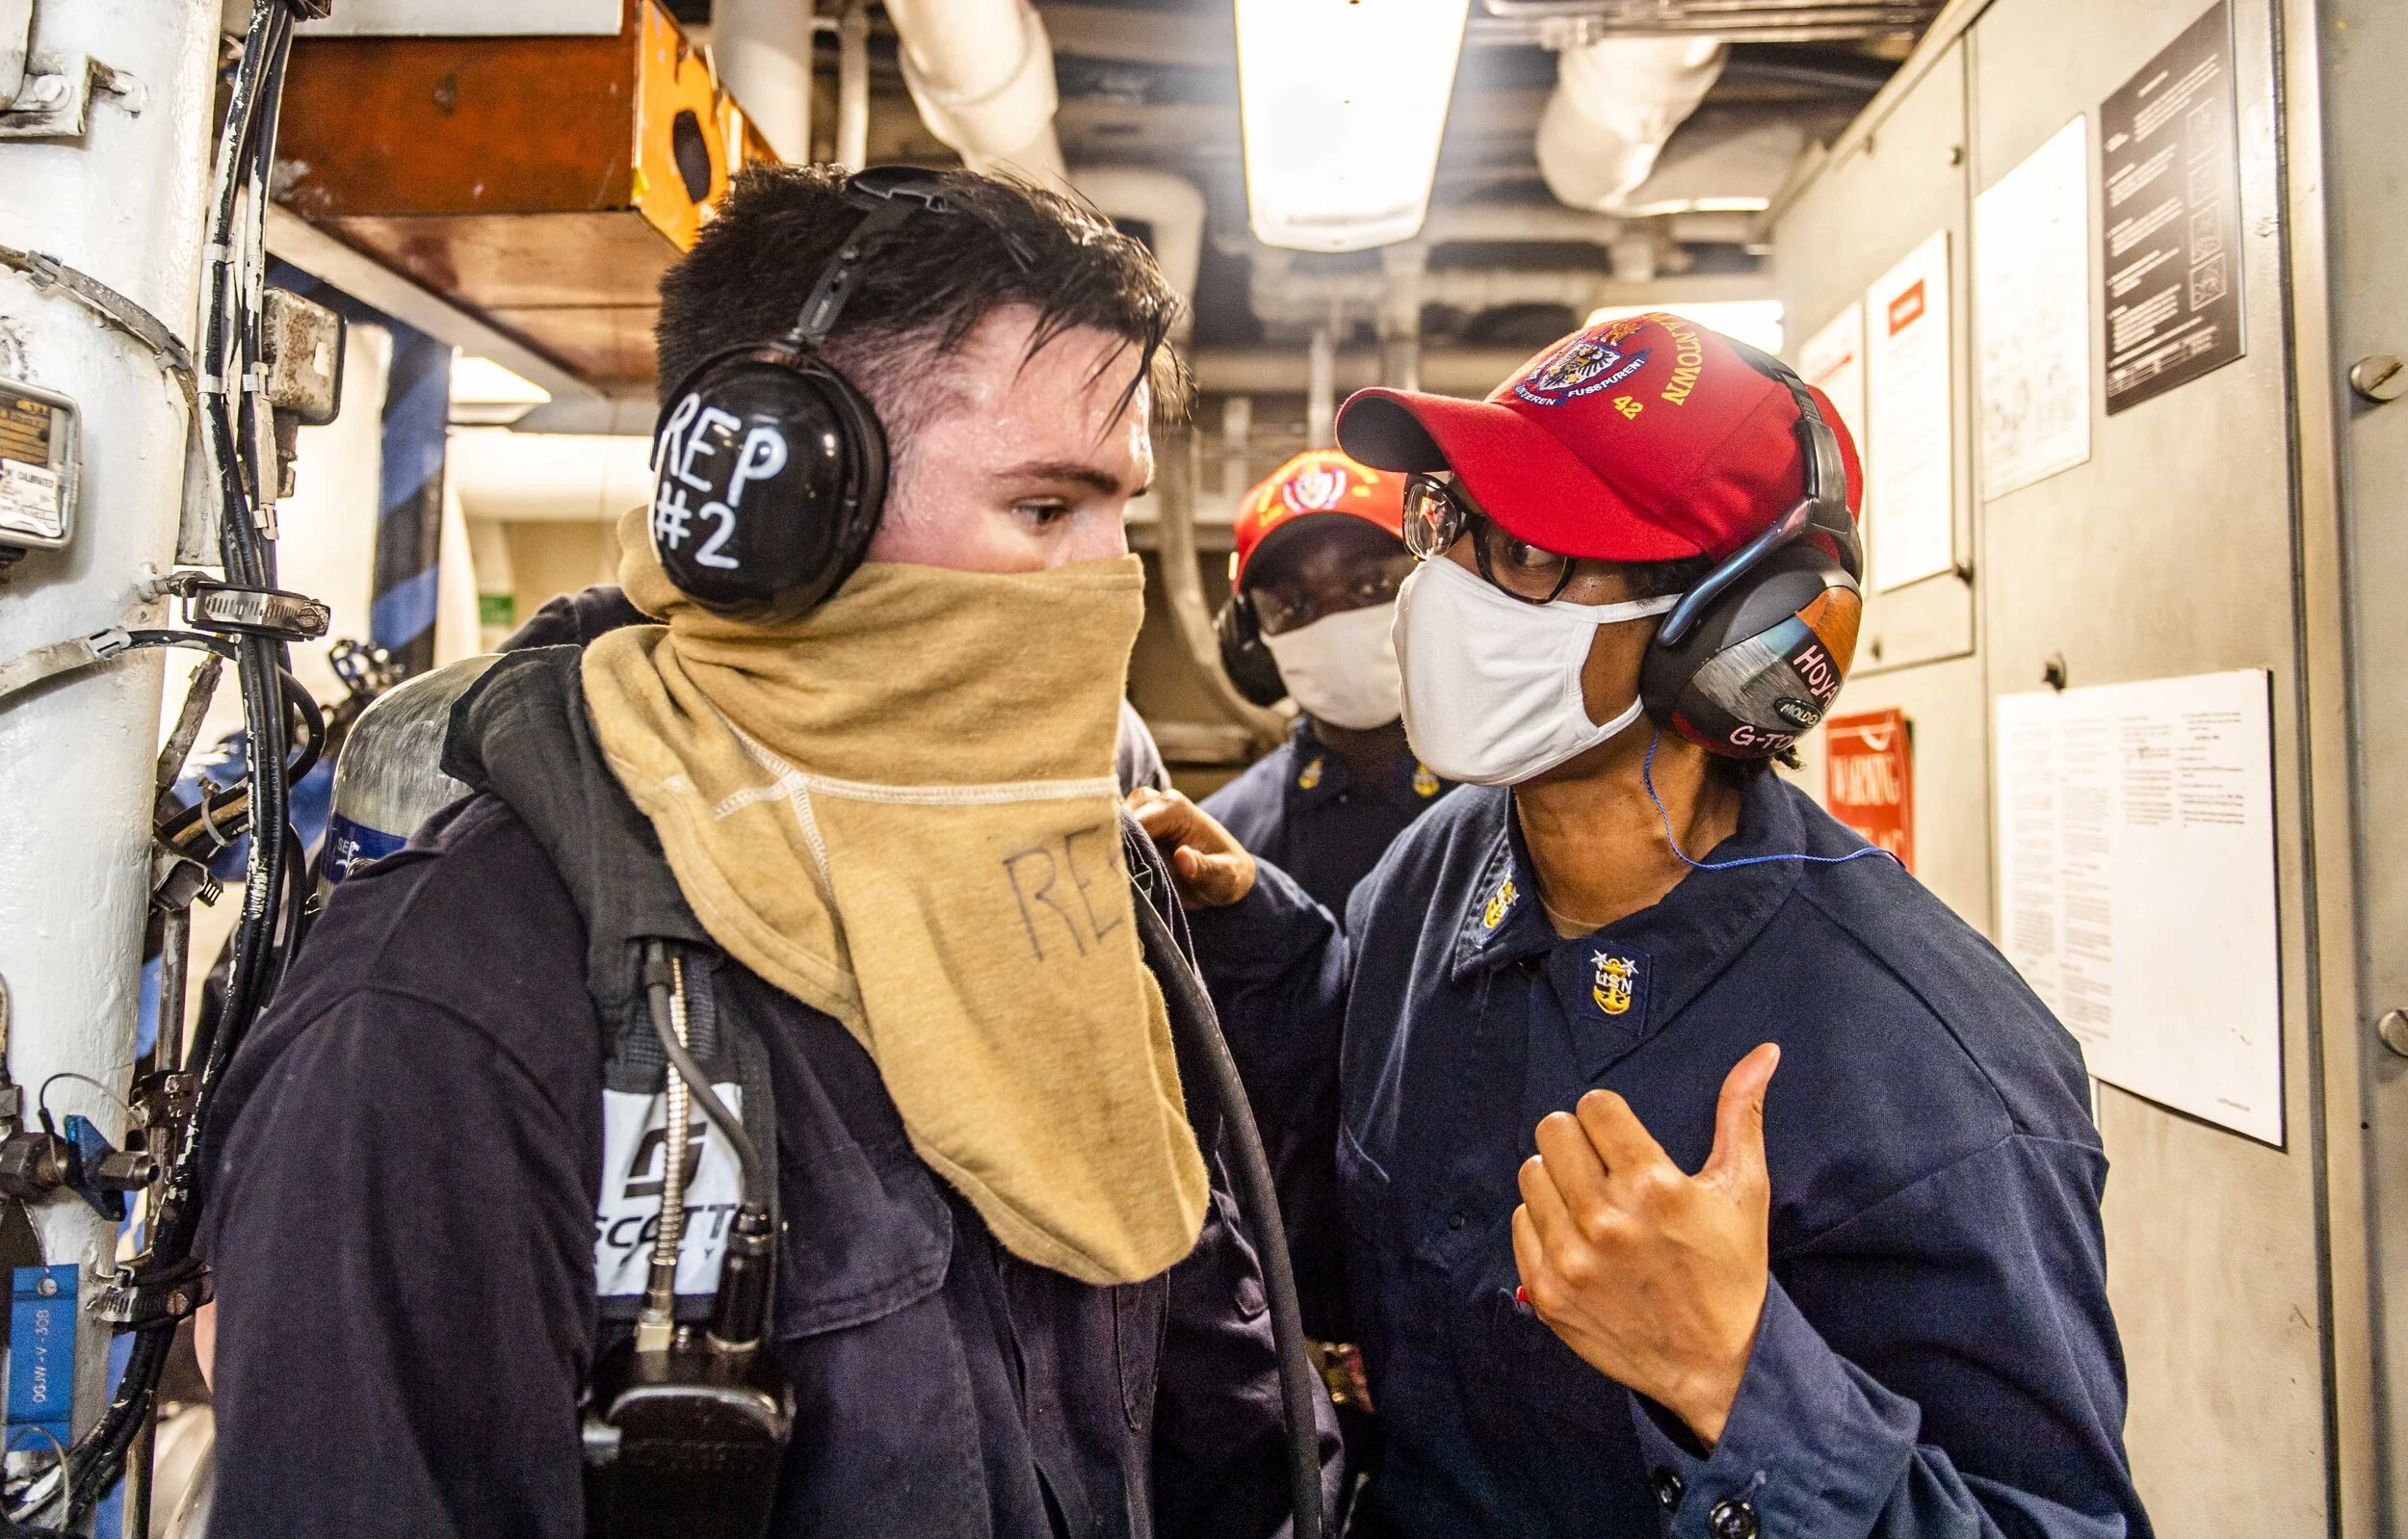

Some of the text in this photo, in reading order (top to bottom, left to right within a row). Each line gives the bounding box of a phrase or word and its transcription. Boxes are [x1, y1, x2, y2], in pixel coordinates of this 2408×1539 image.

[1645, 313, 1703, 405] ANTOWN
[657, 392, 788, 508] REP
[1613, 395, 1643, 420] 42
[655, 481, 740, 569] #2
[1730, 725, 1797, 749] G-TO
[1002, 824, 1124, 963] RE
[1595, 971, 1634, 995] USN
